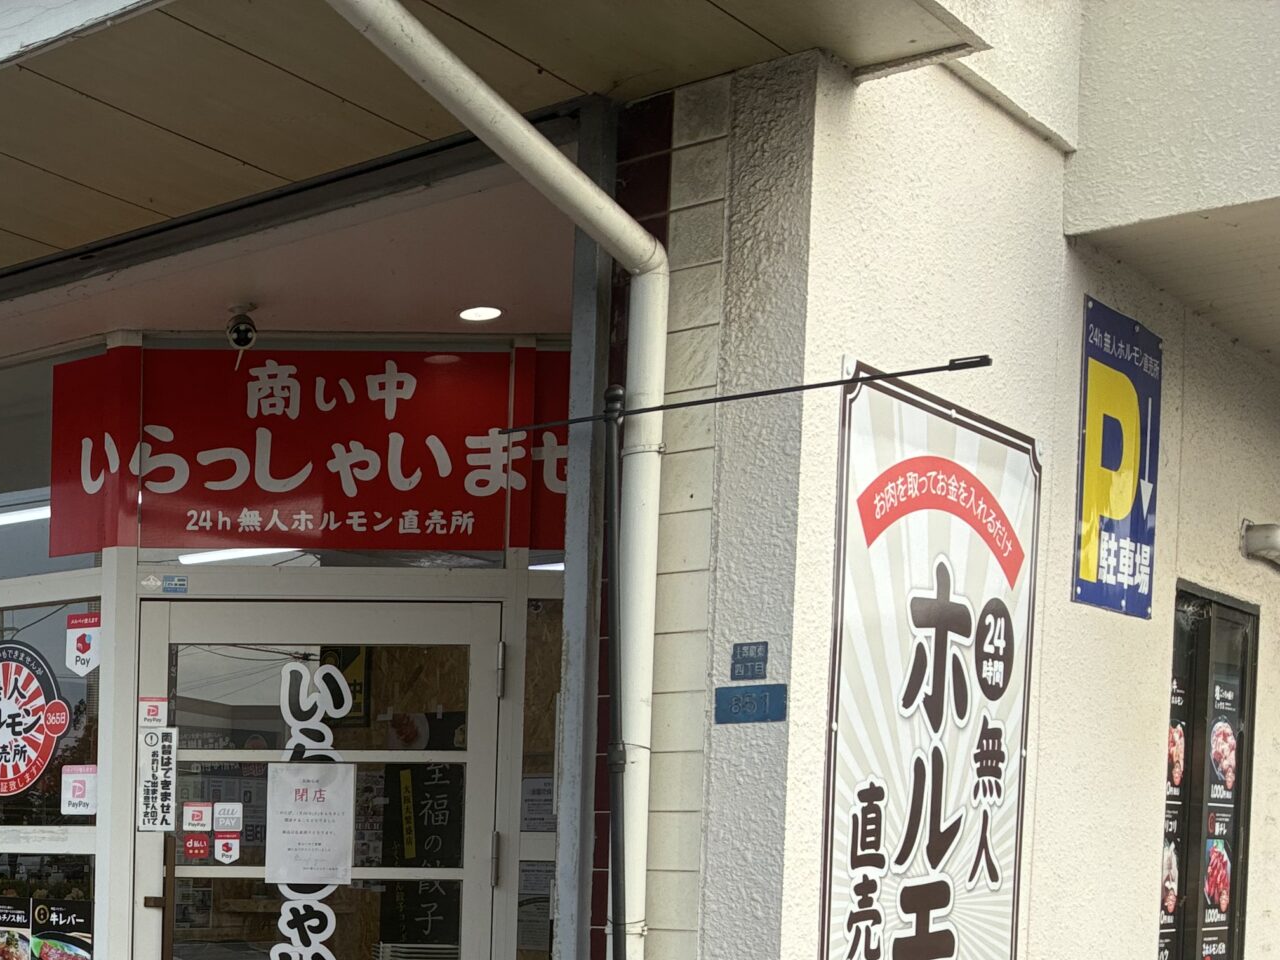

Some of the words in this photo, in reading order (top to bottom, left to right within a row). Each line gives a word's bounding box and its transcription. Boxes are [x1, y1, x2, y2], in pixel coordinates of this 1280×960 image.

[246, 359, 417, 420] 商い中
[80, 424, 568, 498] いらっしゃいませ
[186, 507, 475, 535] 24h無人ホルモン直売所
[873, 470, 1013, 557] お肉を取ってお金を入れるだけ
[1098, 530, 1151, 596] 駐車場
[983, 614, 1006, 655] 24
[75, 655, 91, 667] Pay
[982, 659, 1004, 688] 時間
[46, 712, 66, 725] 365日
[160, 731, 173, 826] 両替はできません
[67, 800, 90, 809] PayPay
[294, 788, 326, 803] 閉店
[968, 714, 1006, 883] 無人
[219, 818, 237, 826] PAY
[221, 853, 233, 861] Pay
[49, 914, 85, 926] 牛レバー
